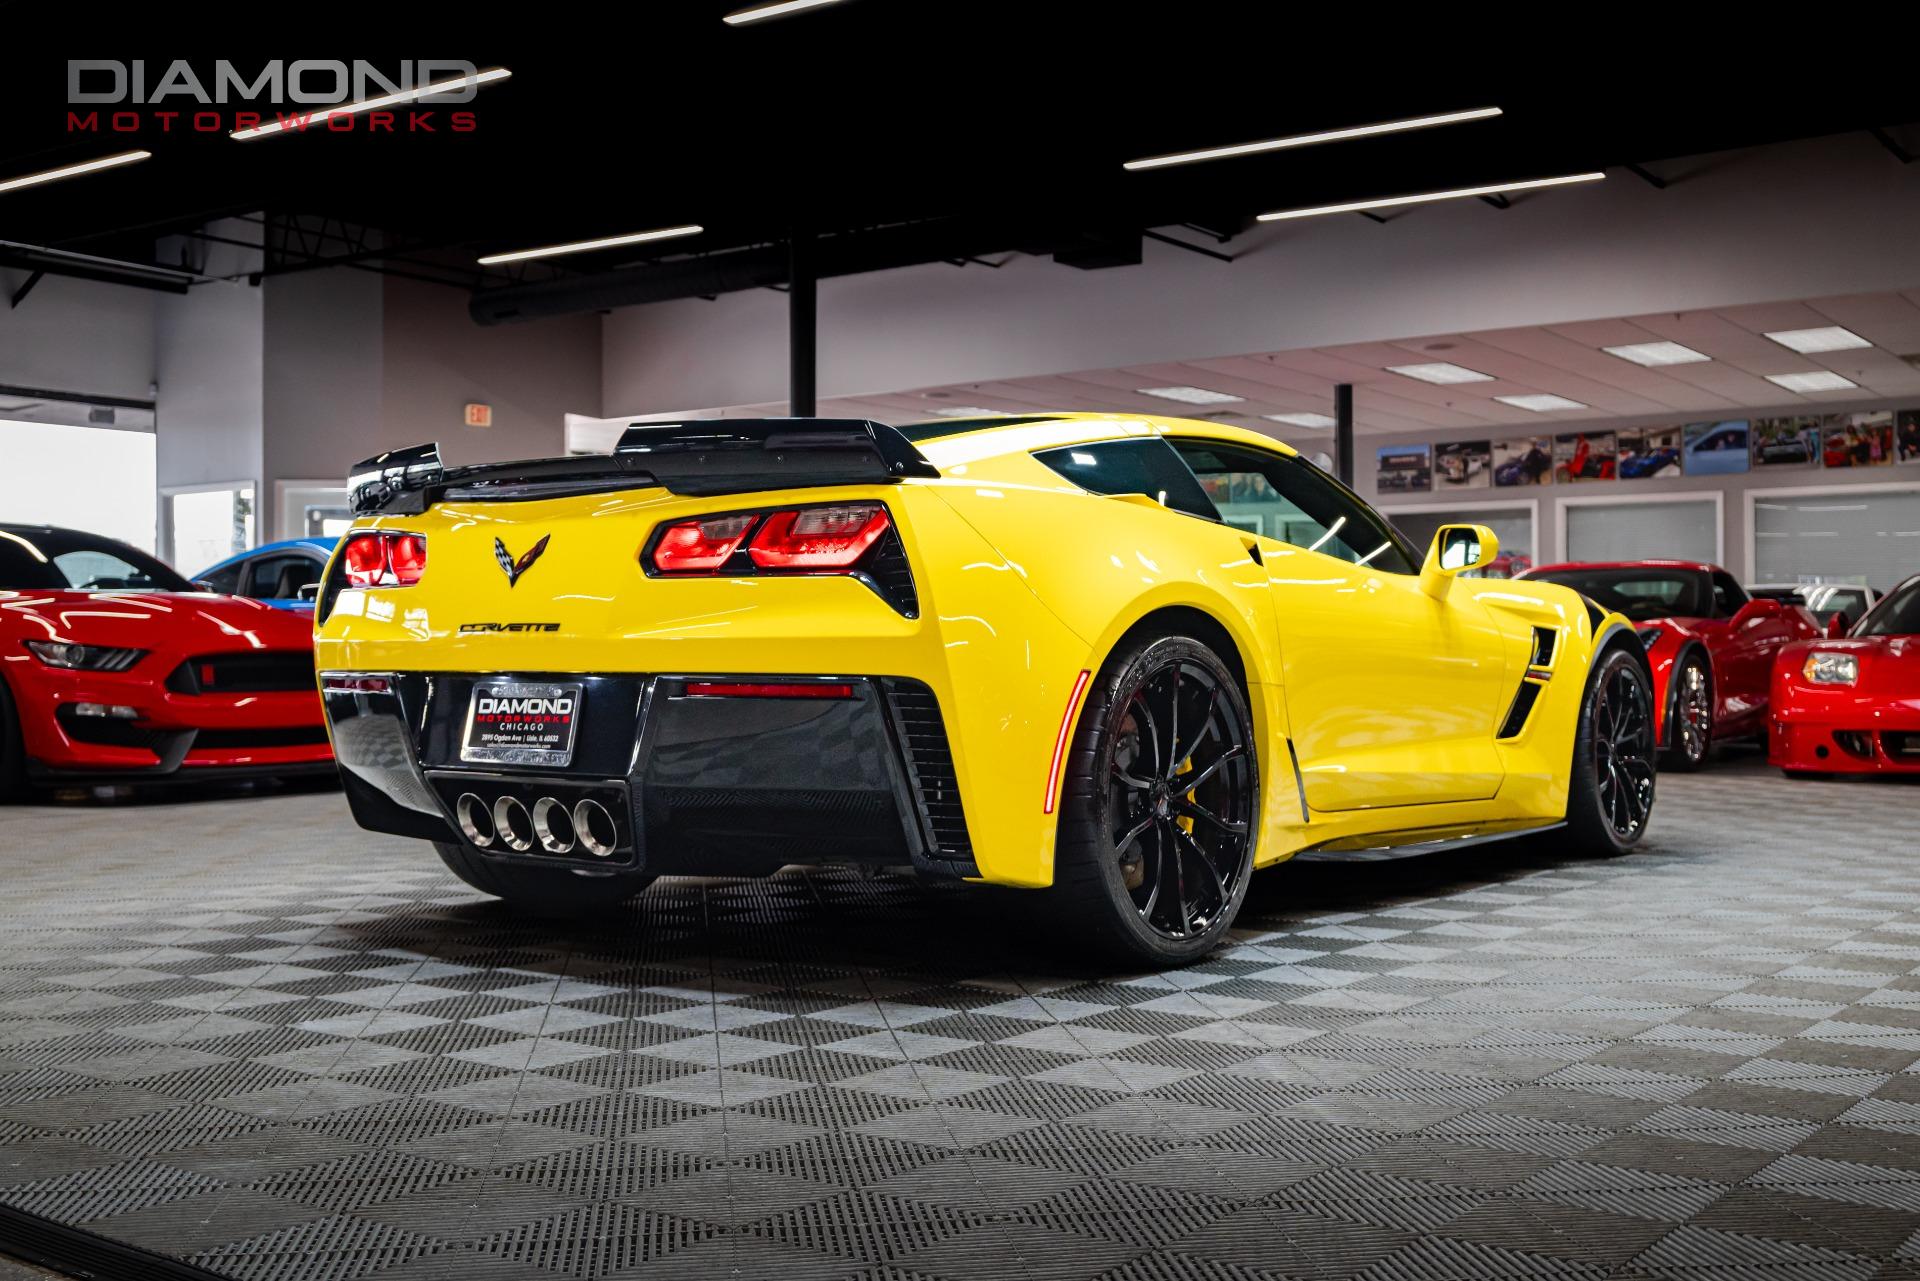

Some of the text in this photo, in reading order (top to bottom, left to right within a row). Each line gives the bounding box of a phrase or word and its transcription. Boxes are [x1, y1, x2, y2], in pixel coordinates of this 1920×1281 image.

[459, 622, 561, 633] CORVETTE
[478, 698, 573, 715] DIAMOND
[476, 714, 571, 723] MOTORWORKS
[499, 723, 544, 731] CHICAGO
[494, 734, 511, 743] Ogden
